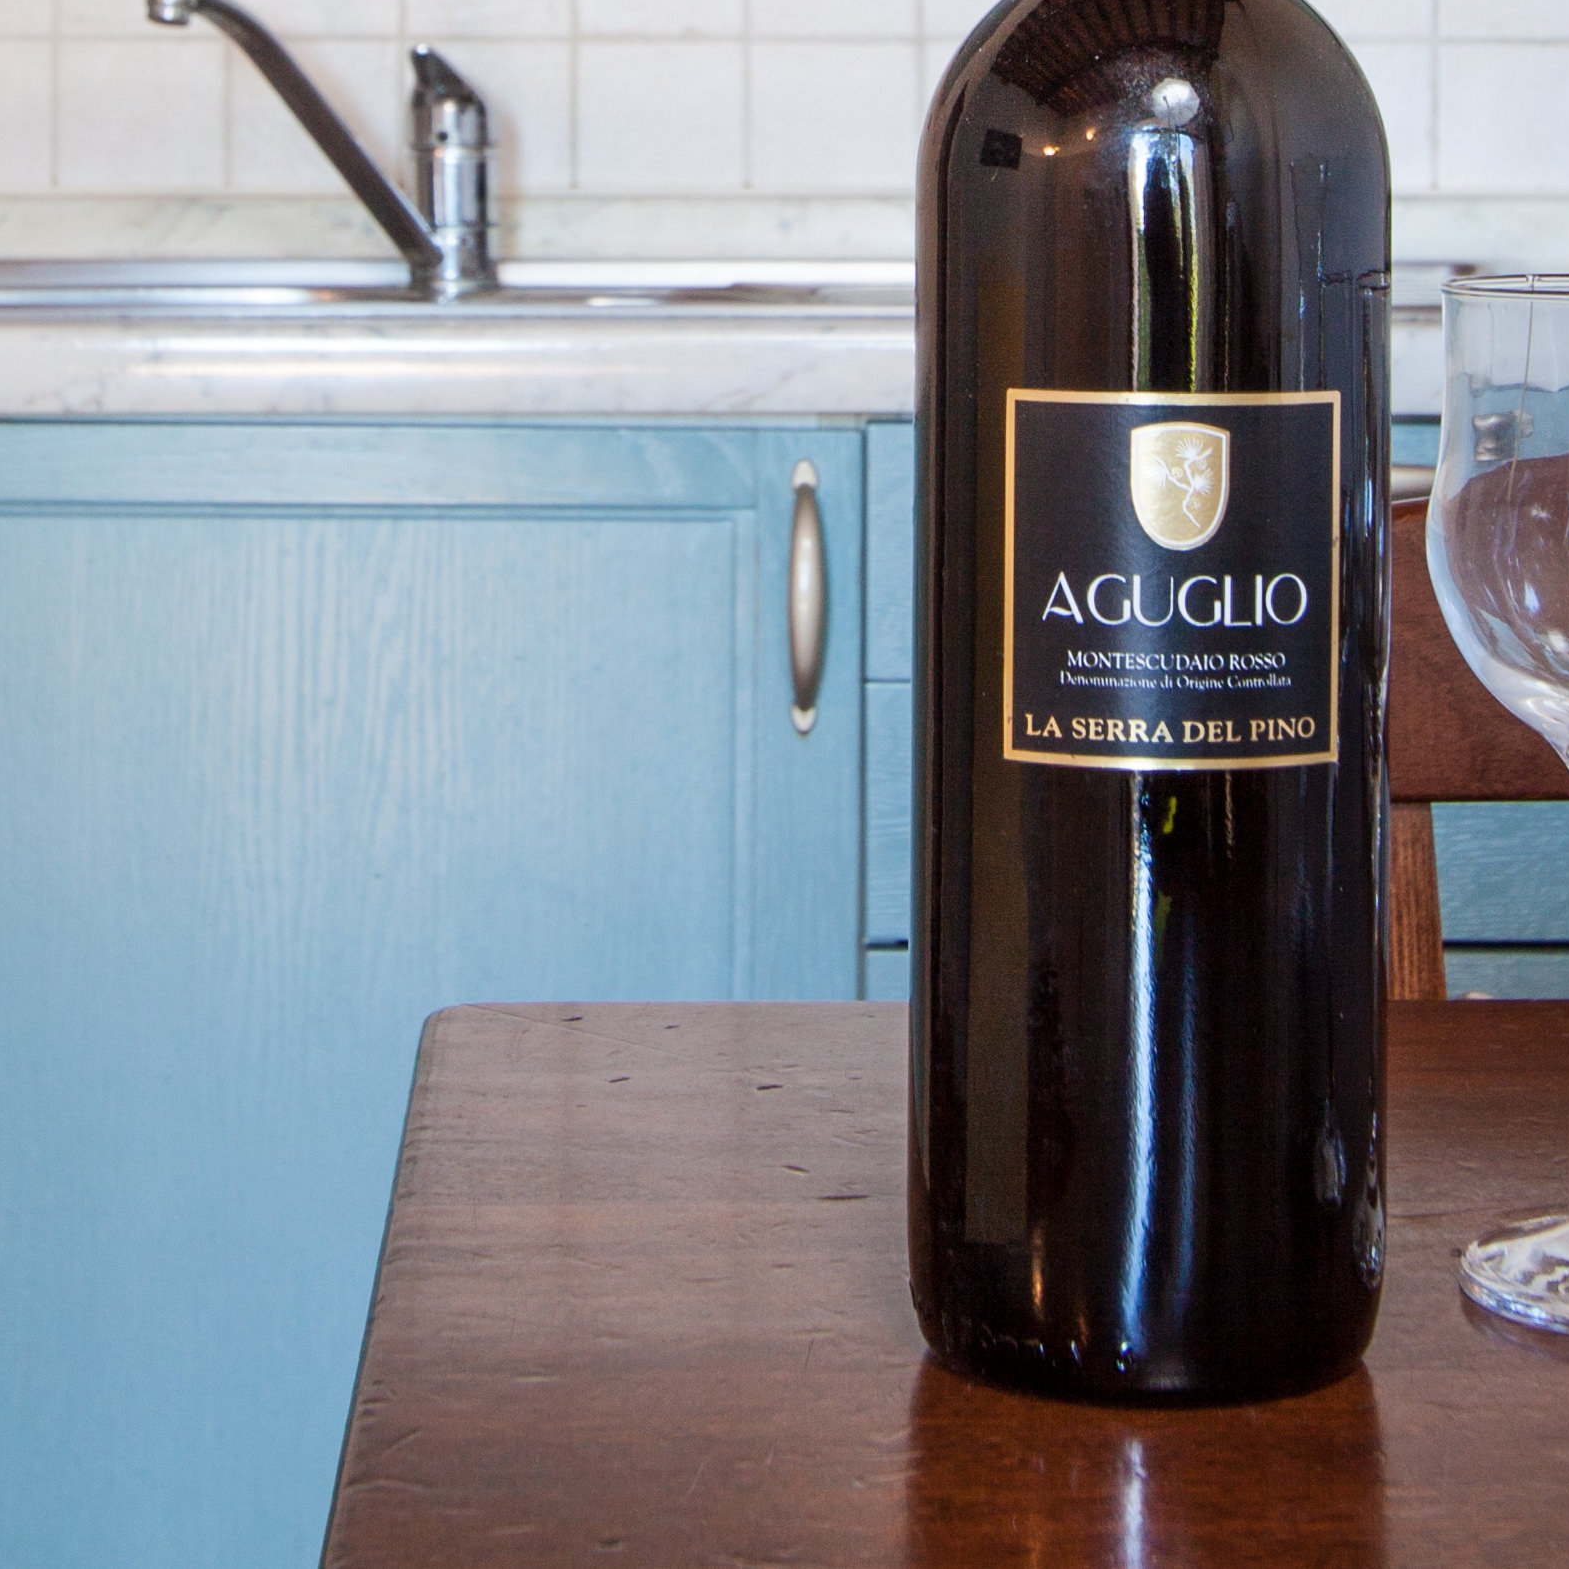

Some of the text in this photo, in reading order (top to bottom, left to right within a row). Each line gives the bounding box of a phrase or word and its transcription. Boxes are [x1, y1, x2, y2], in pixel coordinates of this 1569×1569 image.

[1041, 571, 1308, 628] AGUGLIO
[1067, 649, 1286, 671] MONTESCUDAIO ROSSO
[1060, 671, 1292, 691] Denominazione di Origine Controllata
[1024, 713, 1316, 744] LA SERRA DEL PINO
